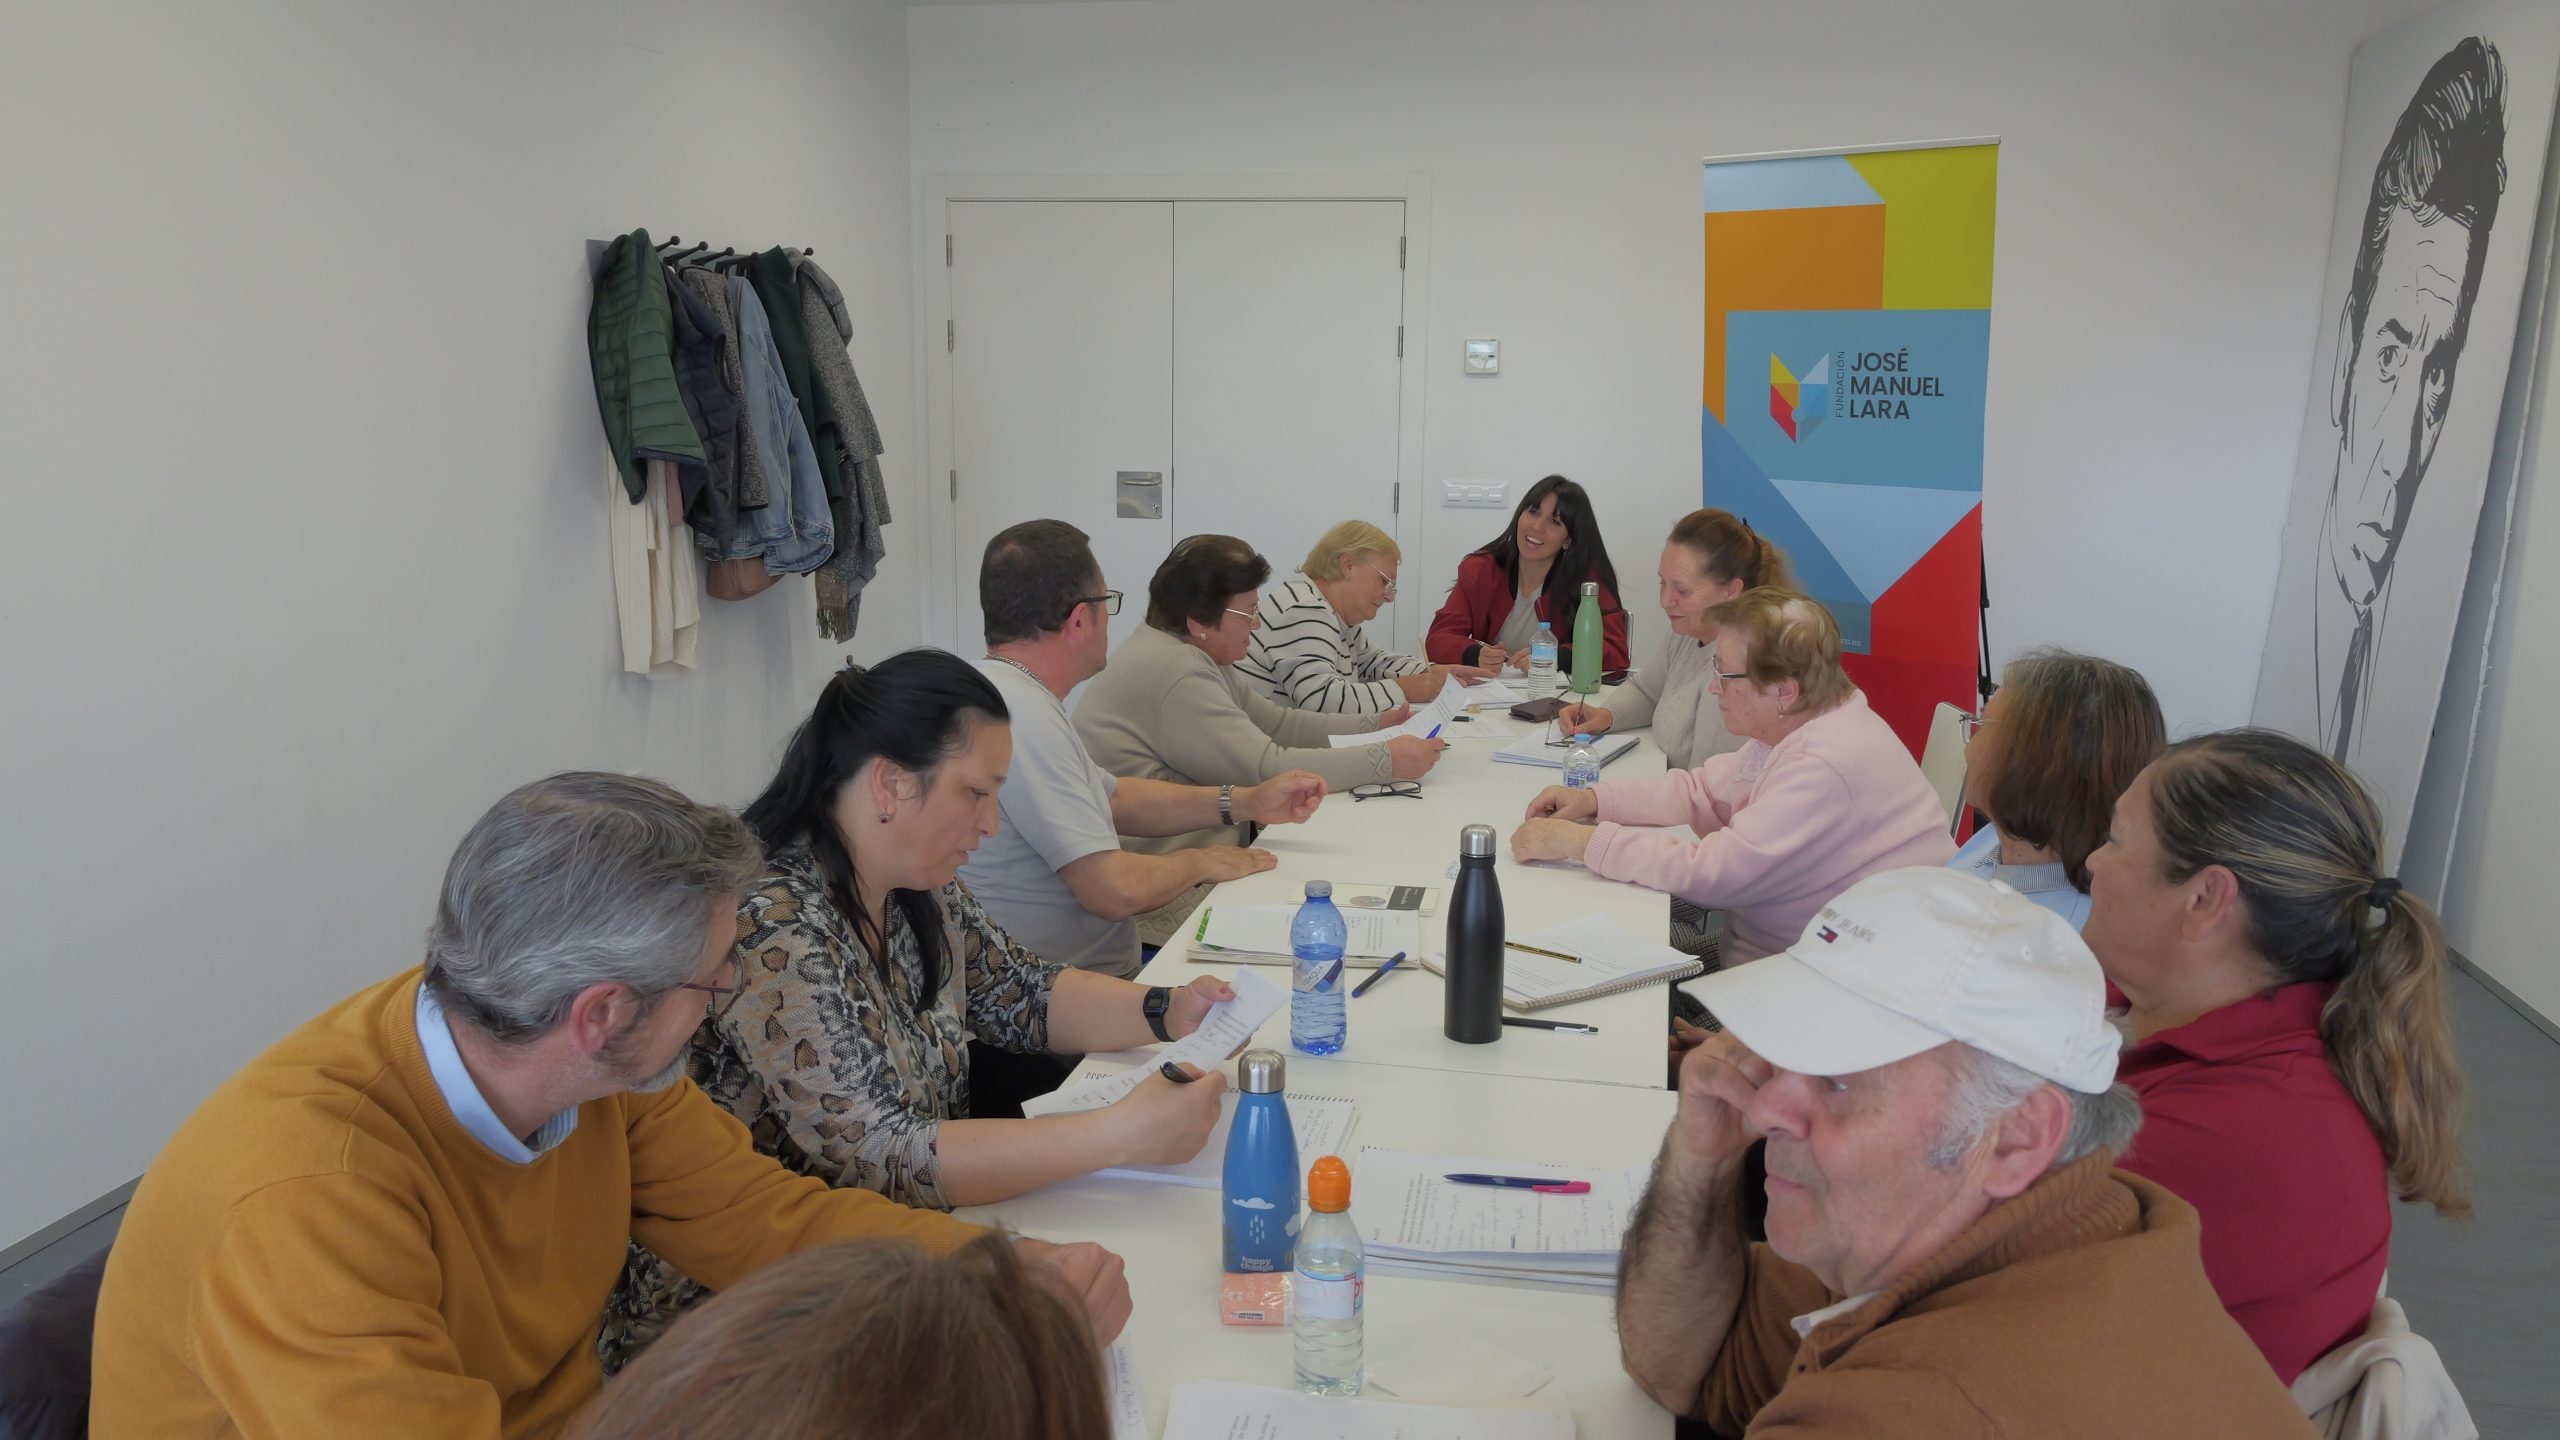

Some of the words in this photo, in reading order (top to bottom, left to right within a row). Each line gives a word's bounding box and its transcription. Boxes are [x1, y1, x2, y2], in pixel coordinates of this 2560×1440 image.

[1851, 348, 1908, 372] JOSÉ
[1835, 351, 1845, 418] FUNDACIÓN
[1850, 376, 1944, 397] MANUEL
[1850, 399, 1910, 419] LARA
[1241, 1255, 1272, 1265] happy
